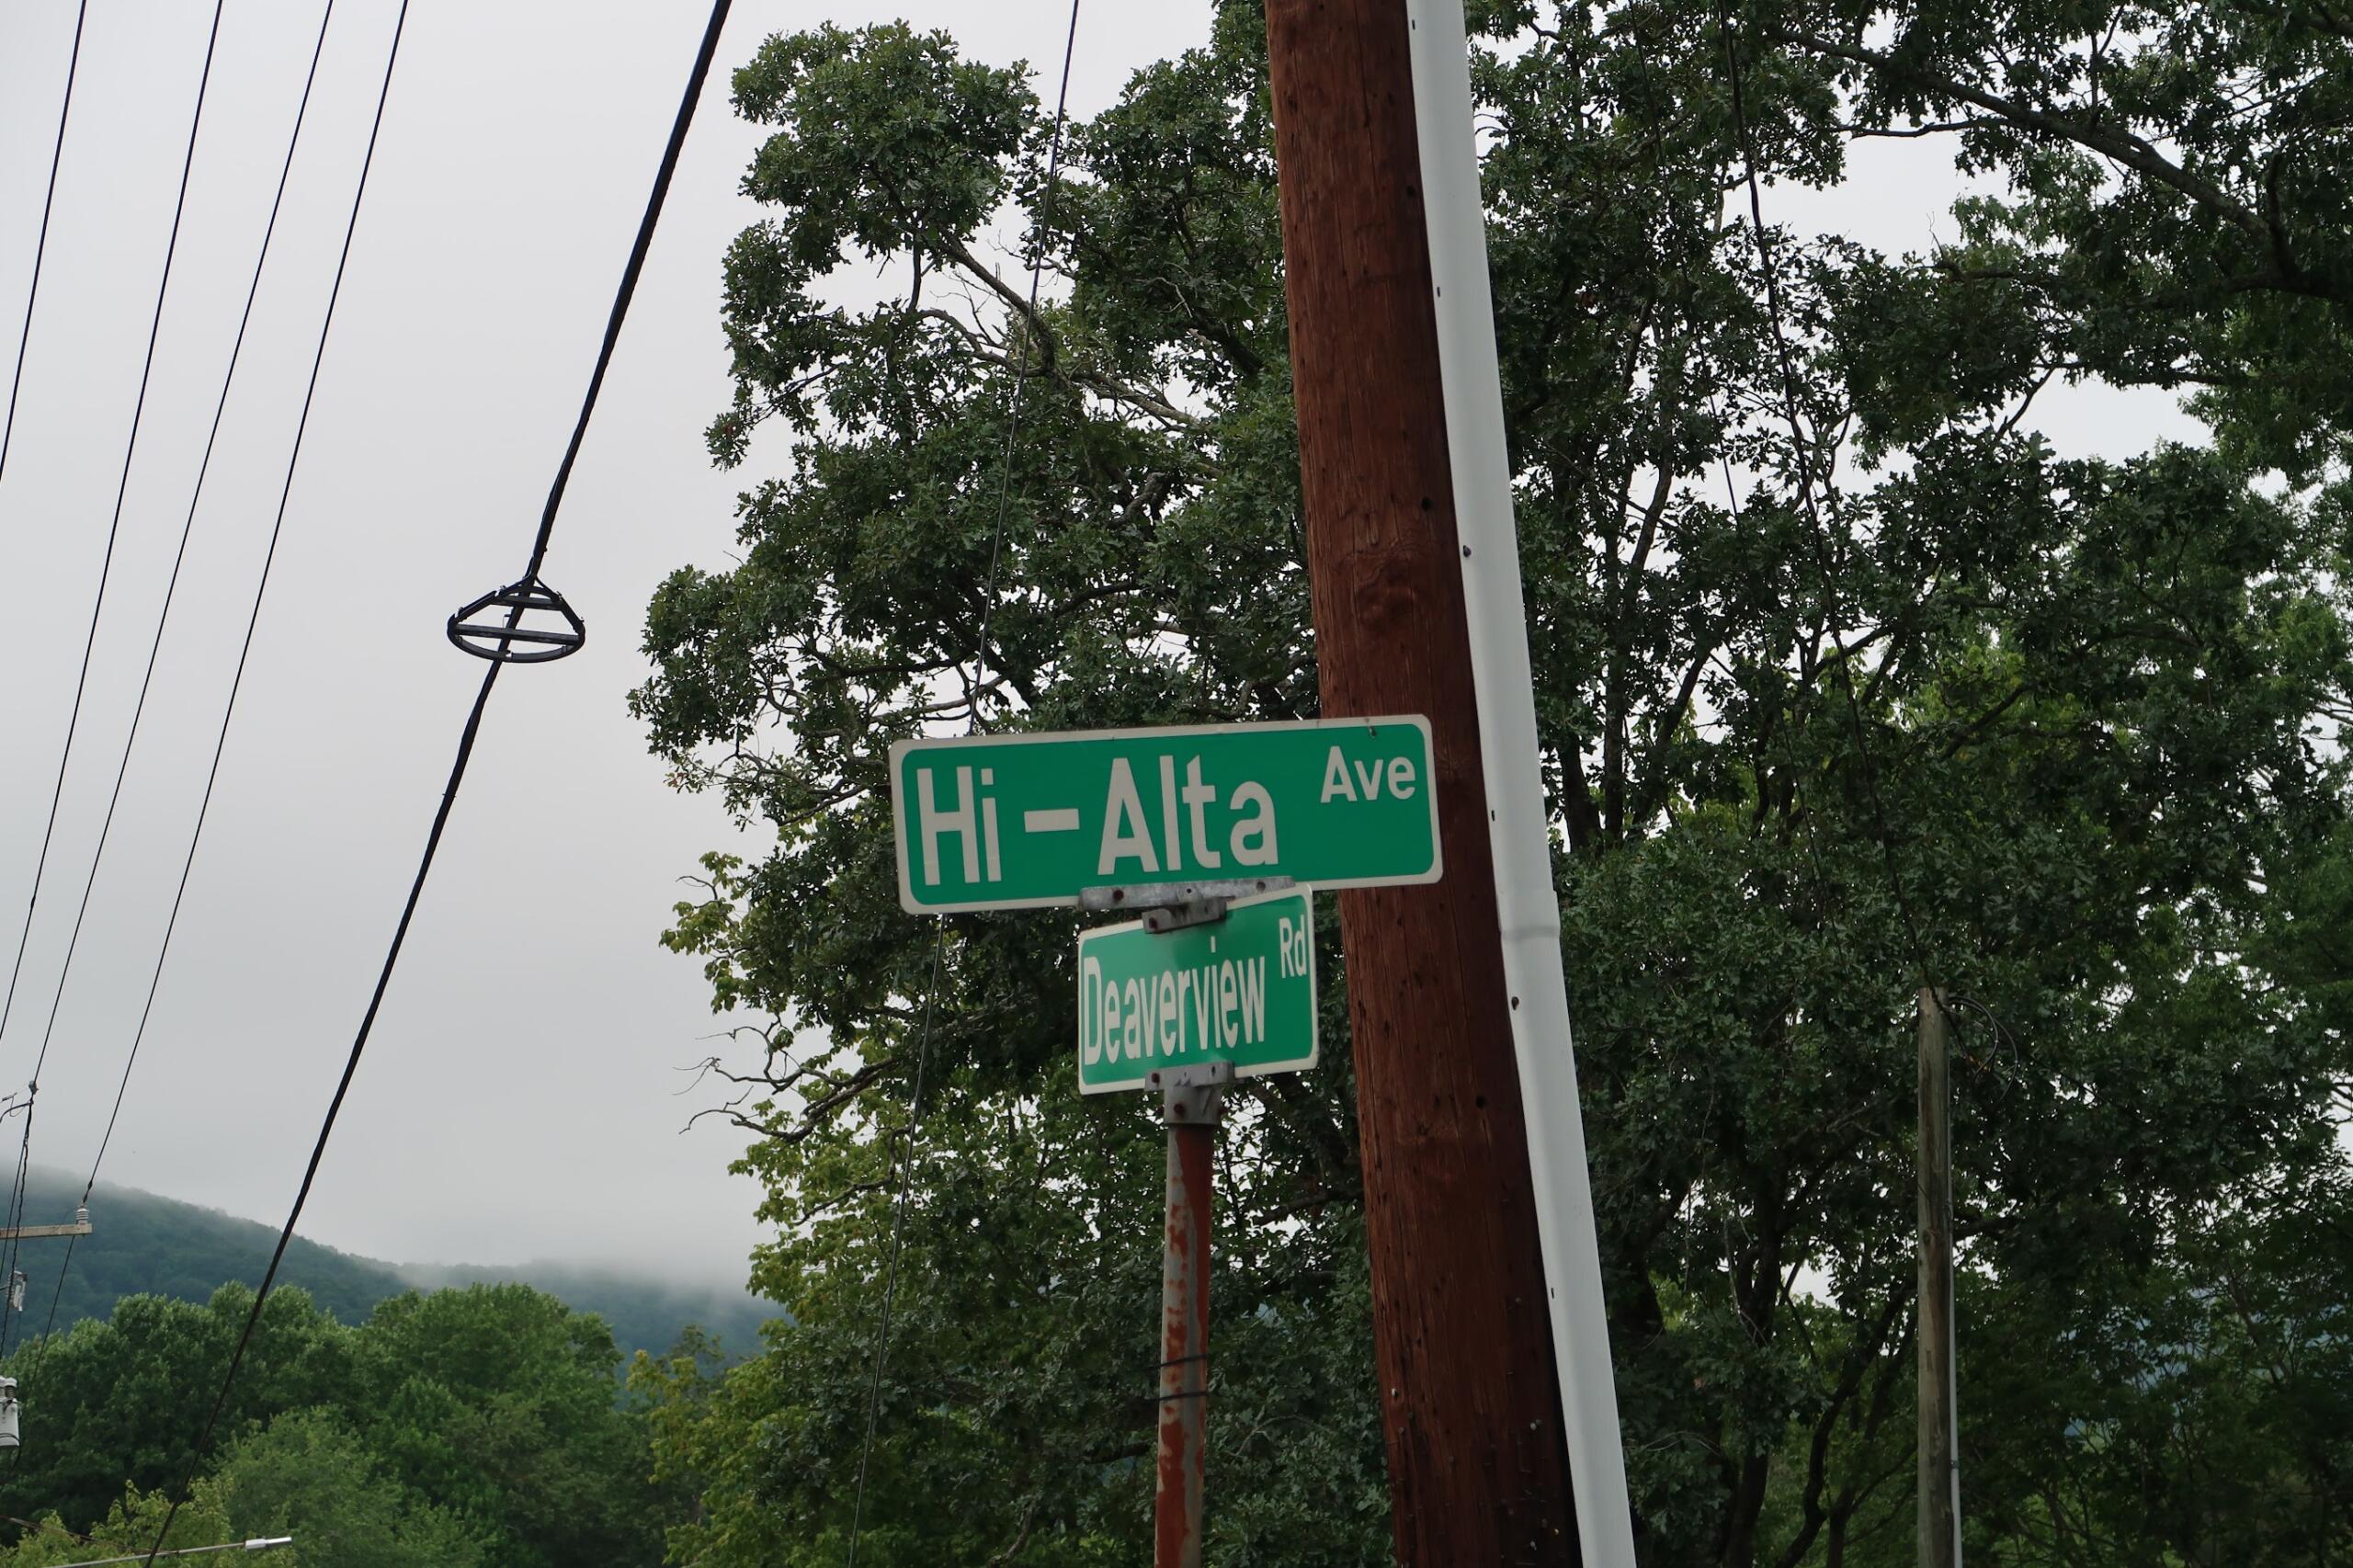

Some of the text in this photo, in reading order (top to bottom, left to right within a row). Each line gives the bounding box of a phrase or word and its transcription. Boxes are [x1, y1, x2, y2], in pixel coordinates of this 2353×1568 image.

[1321, 745, 1416, 804] Ave
[1083, 915, 1307, 1066] Deaverview Rd
